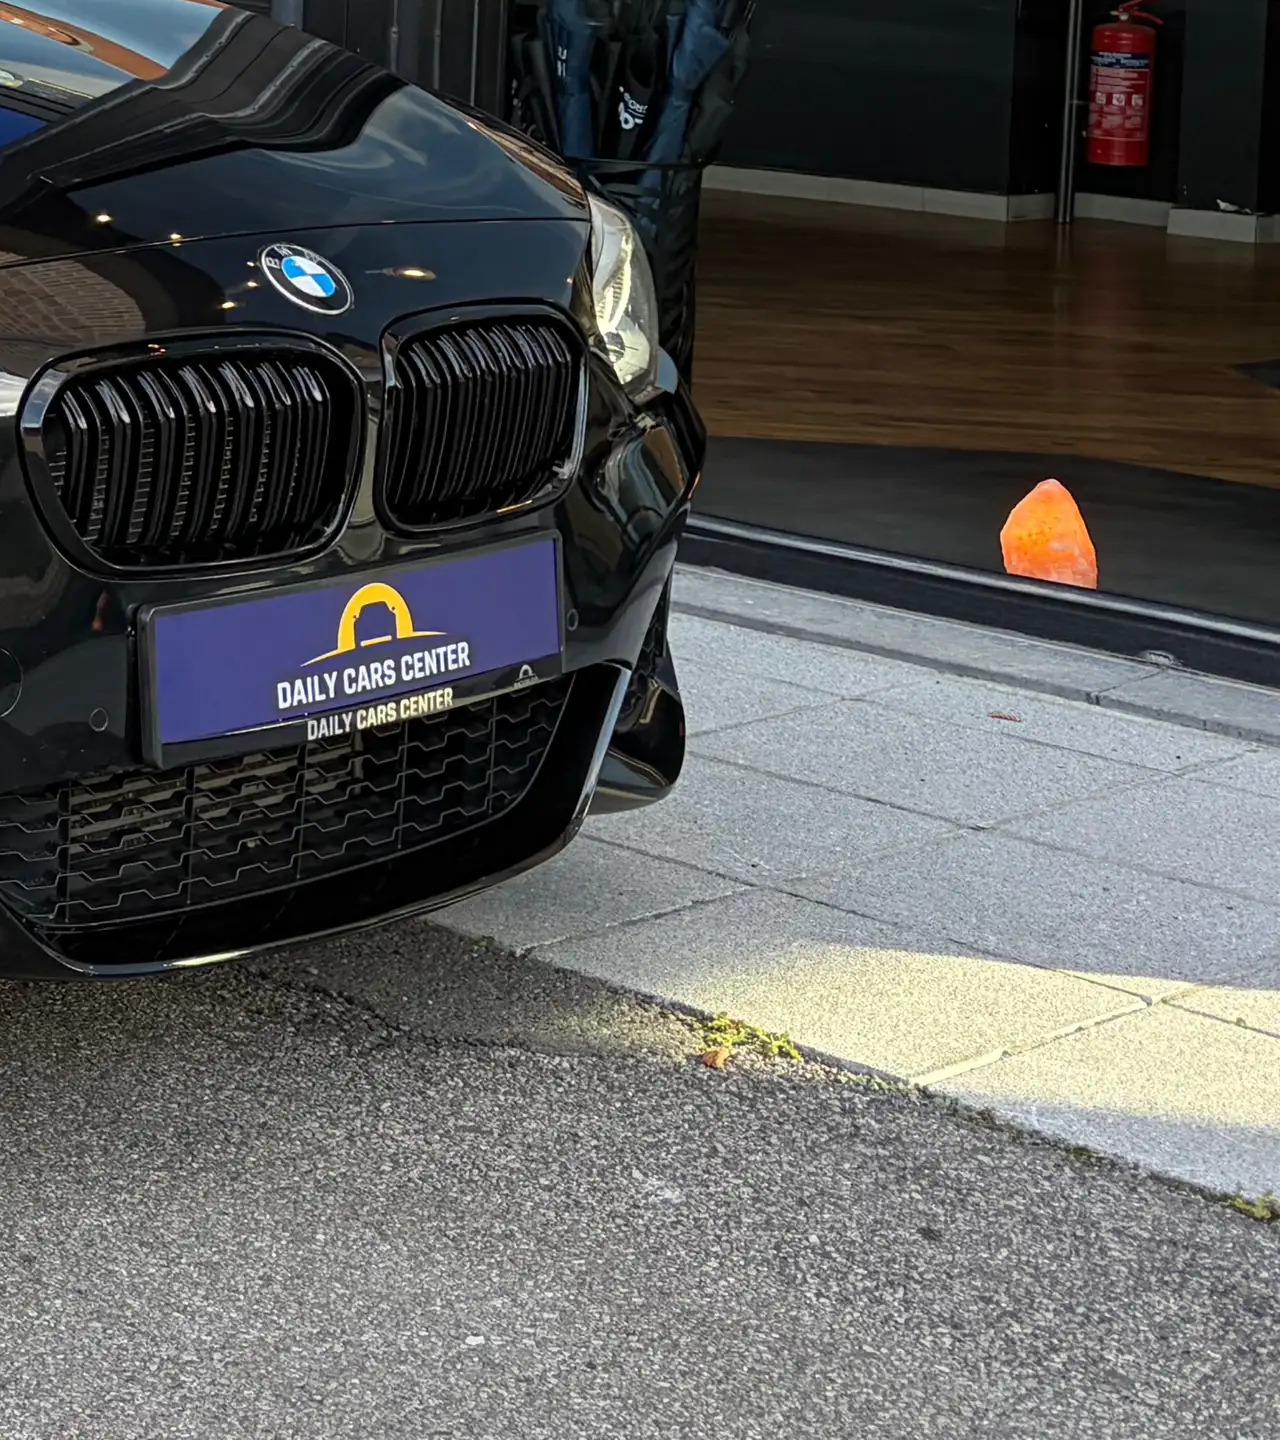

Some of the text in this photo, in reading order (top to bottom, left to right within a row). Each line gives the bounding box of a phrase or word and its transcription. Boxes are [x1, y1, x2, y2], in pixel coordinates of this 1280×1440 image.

[277, 640, 471, 709] DAILY CARS CENTER
[306, 687, 454, 741] DAILY CARS CENTER
